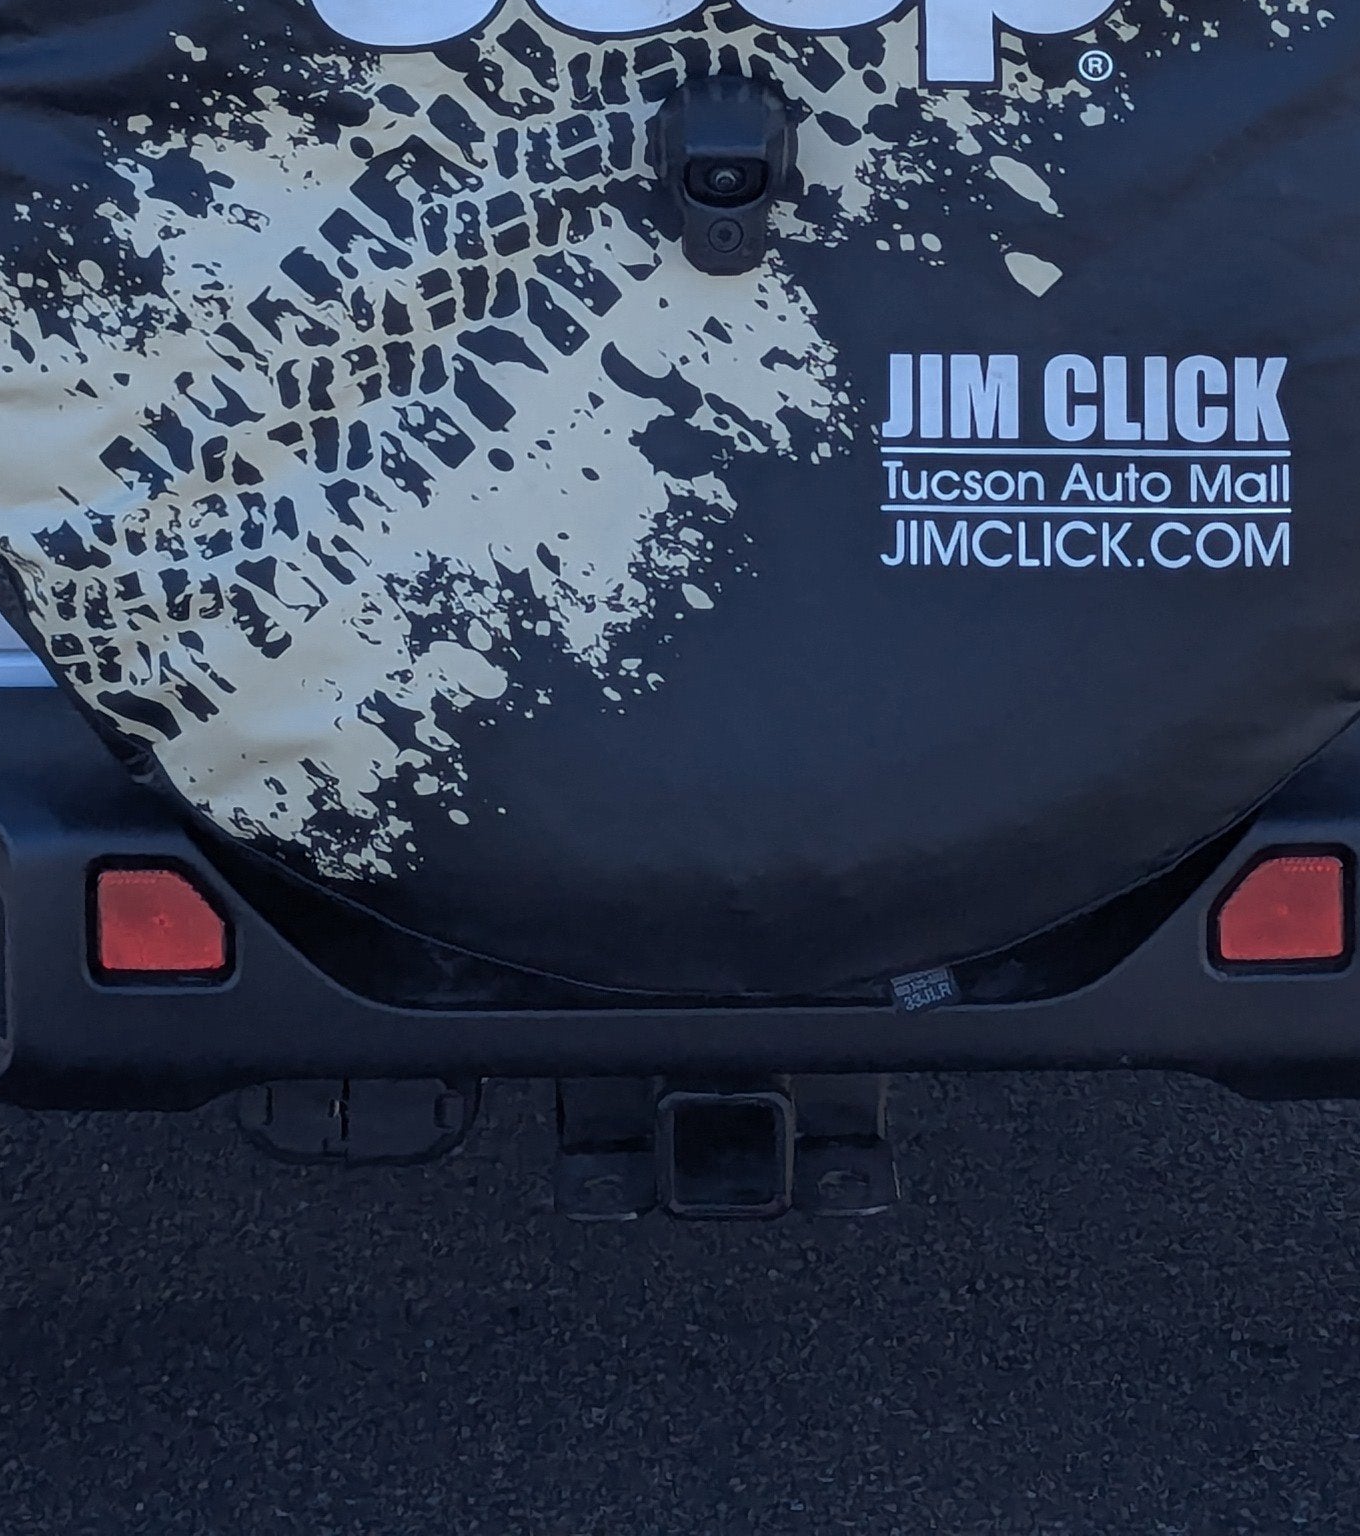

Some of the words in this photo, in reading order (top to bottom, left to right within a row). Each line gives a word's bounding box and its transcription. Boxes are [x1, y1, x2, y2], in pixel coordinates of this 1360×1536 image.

[881, 353, 1019, 439] JIM
[1044, 353, 1290, 443] CLICK
[881, 460, 1045, 502] Tucson
[1060, 463, 1172, 503] Auto
[1190, 464, 1290, 503] Mall
[880, 519, 1290, 568] JIMCLICK.COM
